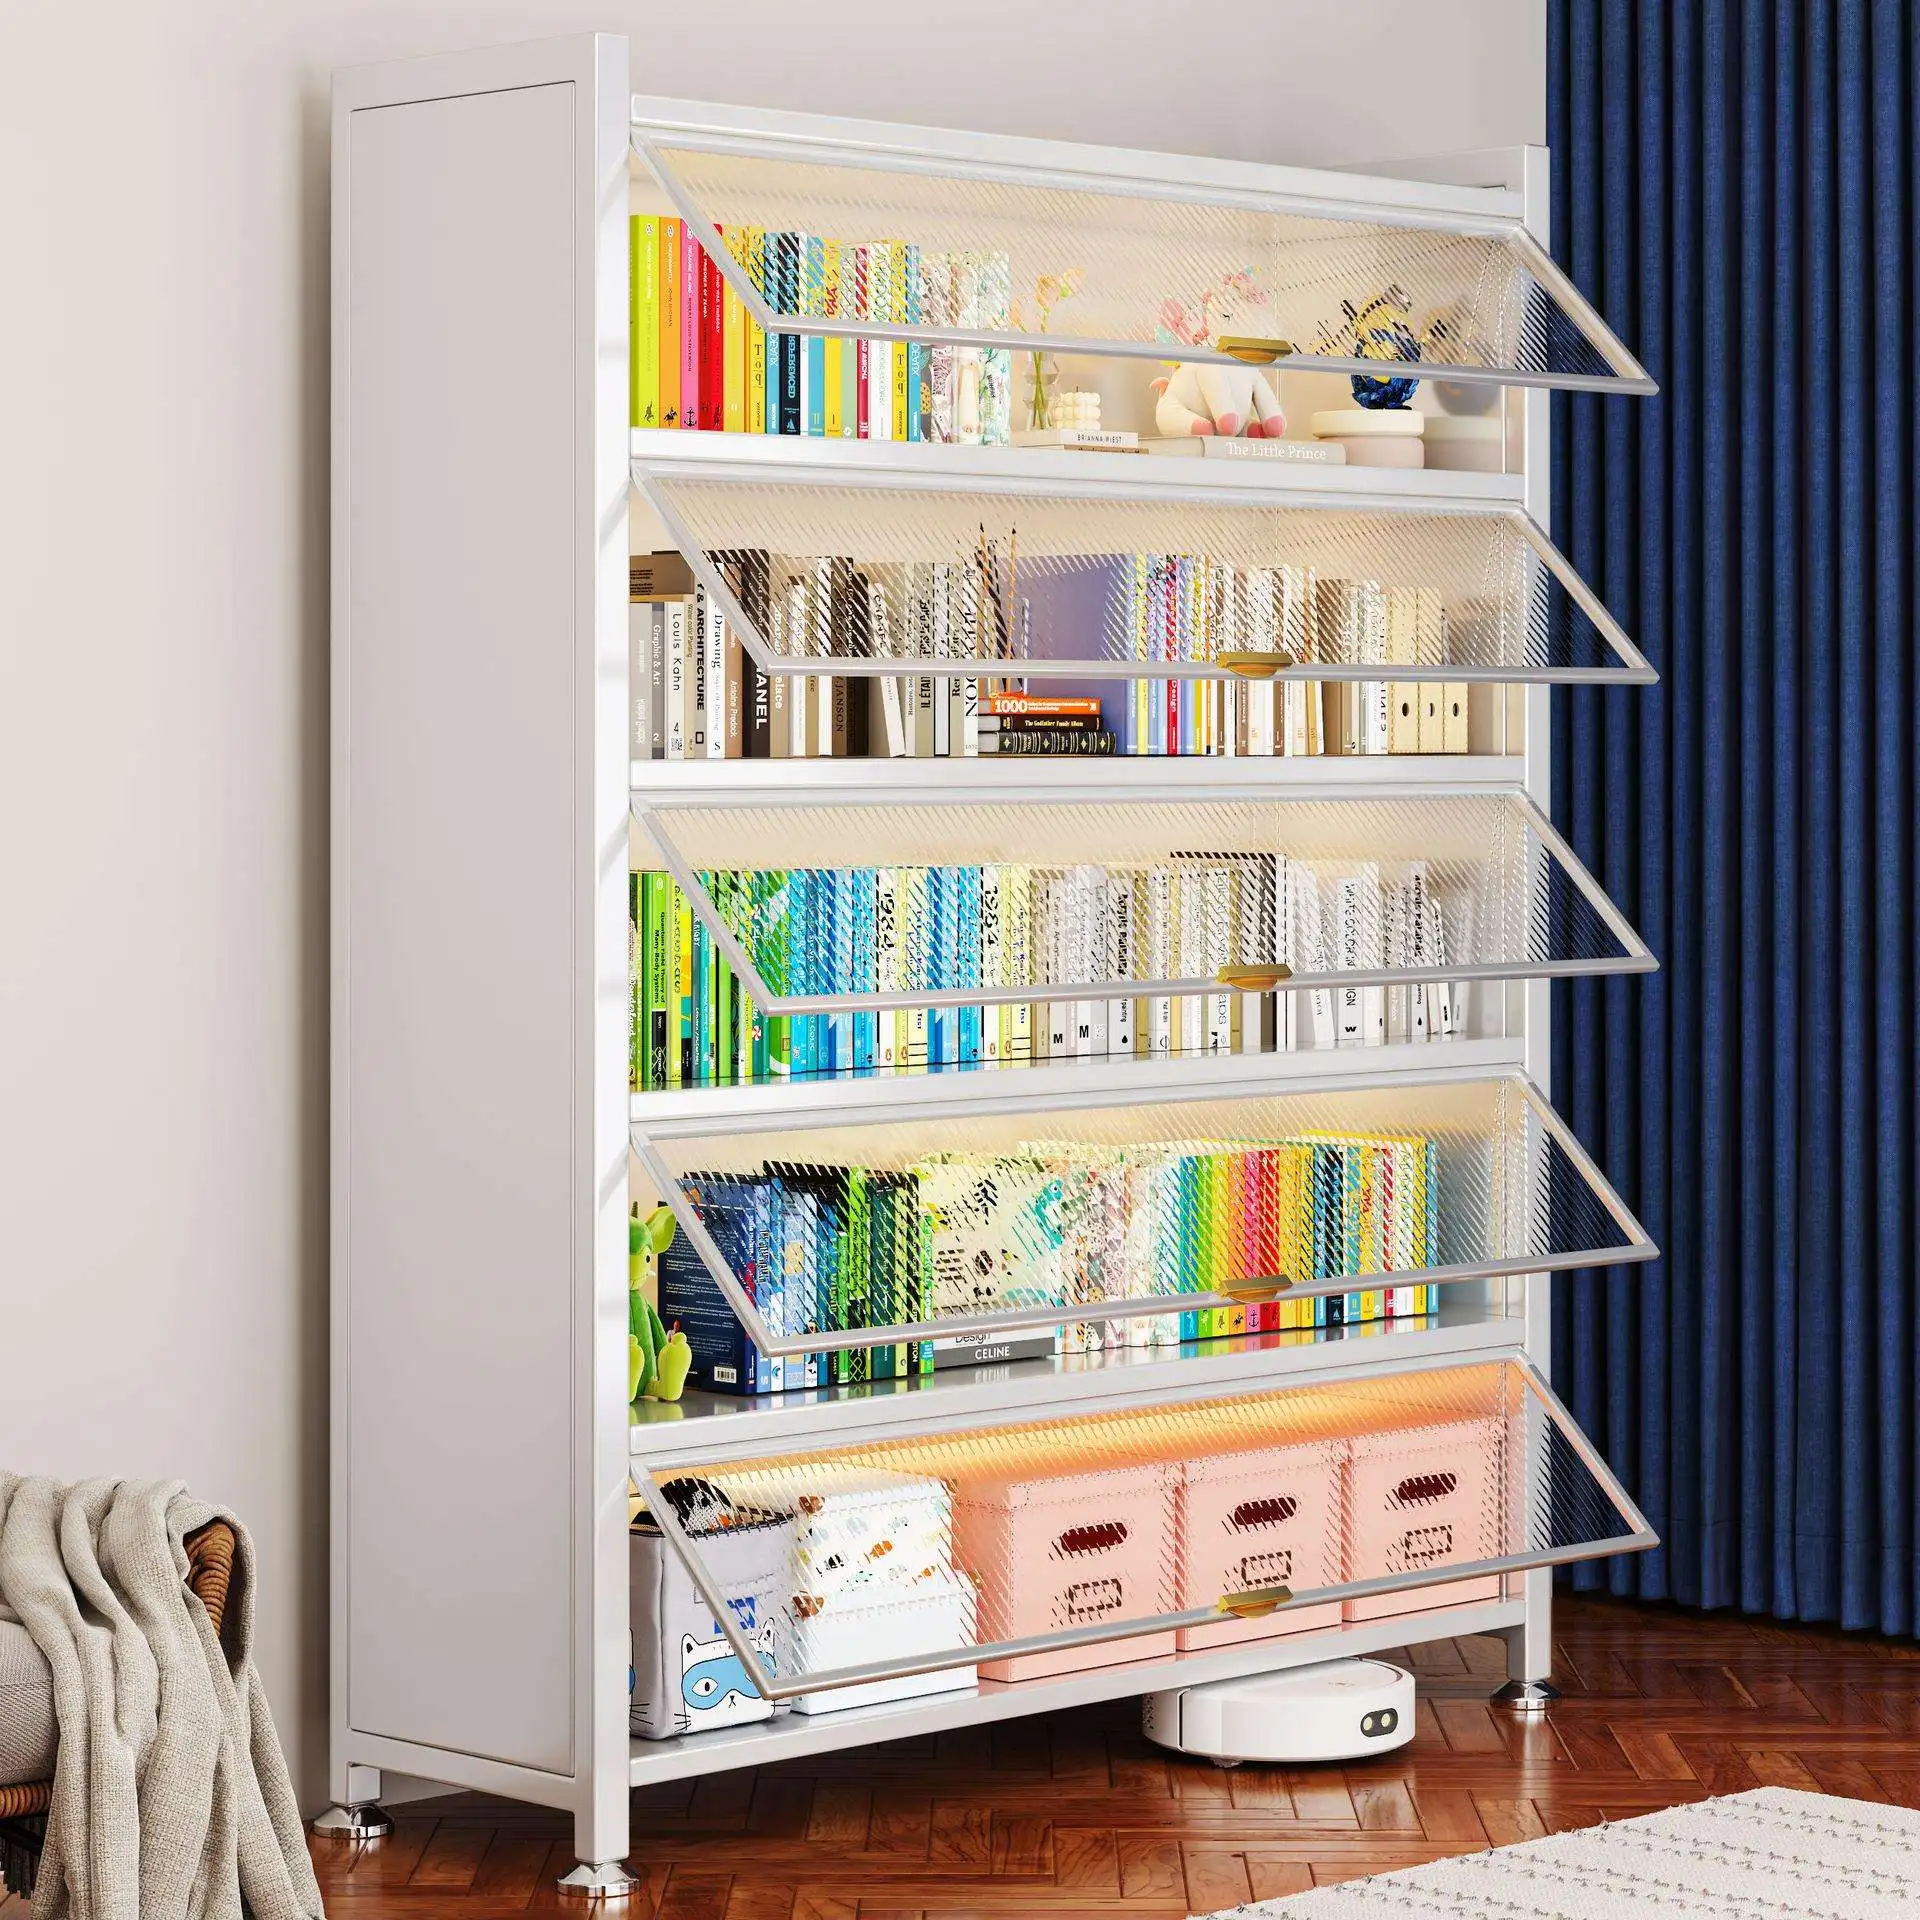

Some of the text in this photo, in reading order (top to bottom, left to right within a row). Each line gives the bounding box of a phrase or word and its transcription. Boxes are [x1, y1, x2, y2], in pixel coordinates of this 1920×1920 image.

[1226, 442, 1327, 461] The Little Prince
[651, 624, 661, 662] Graphic
[711, 614, 723, 669] Drawing
[673, 612, 683, 691] Louis Kahn
[696, 593, 705, 711] & ARCHITECTURE
[653, 672, 661, 686] Art
[994, 699, 1028, 714] 1000
[1053, 1033, 1064, 1044] M
[1079, 1025, 1090, 1038] M
[974, 1345, 1011, 1360] CELINE
